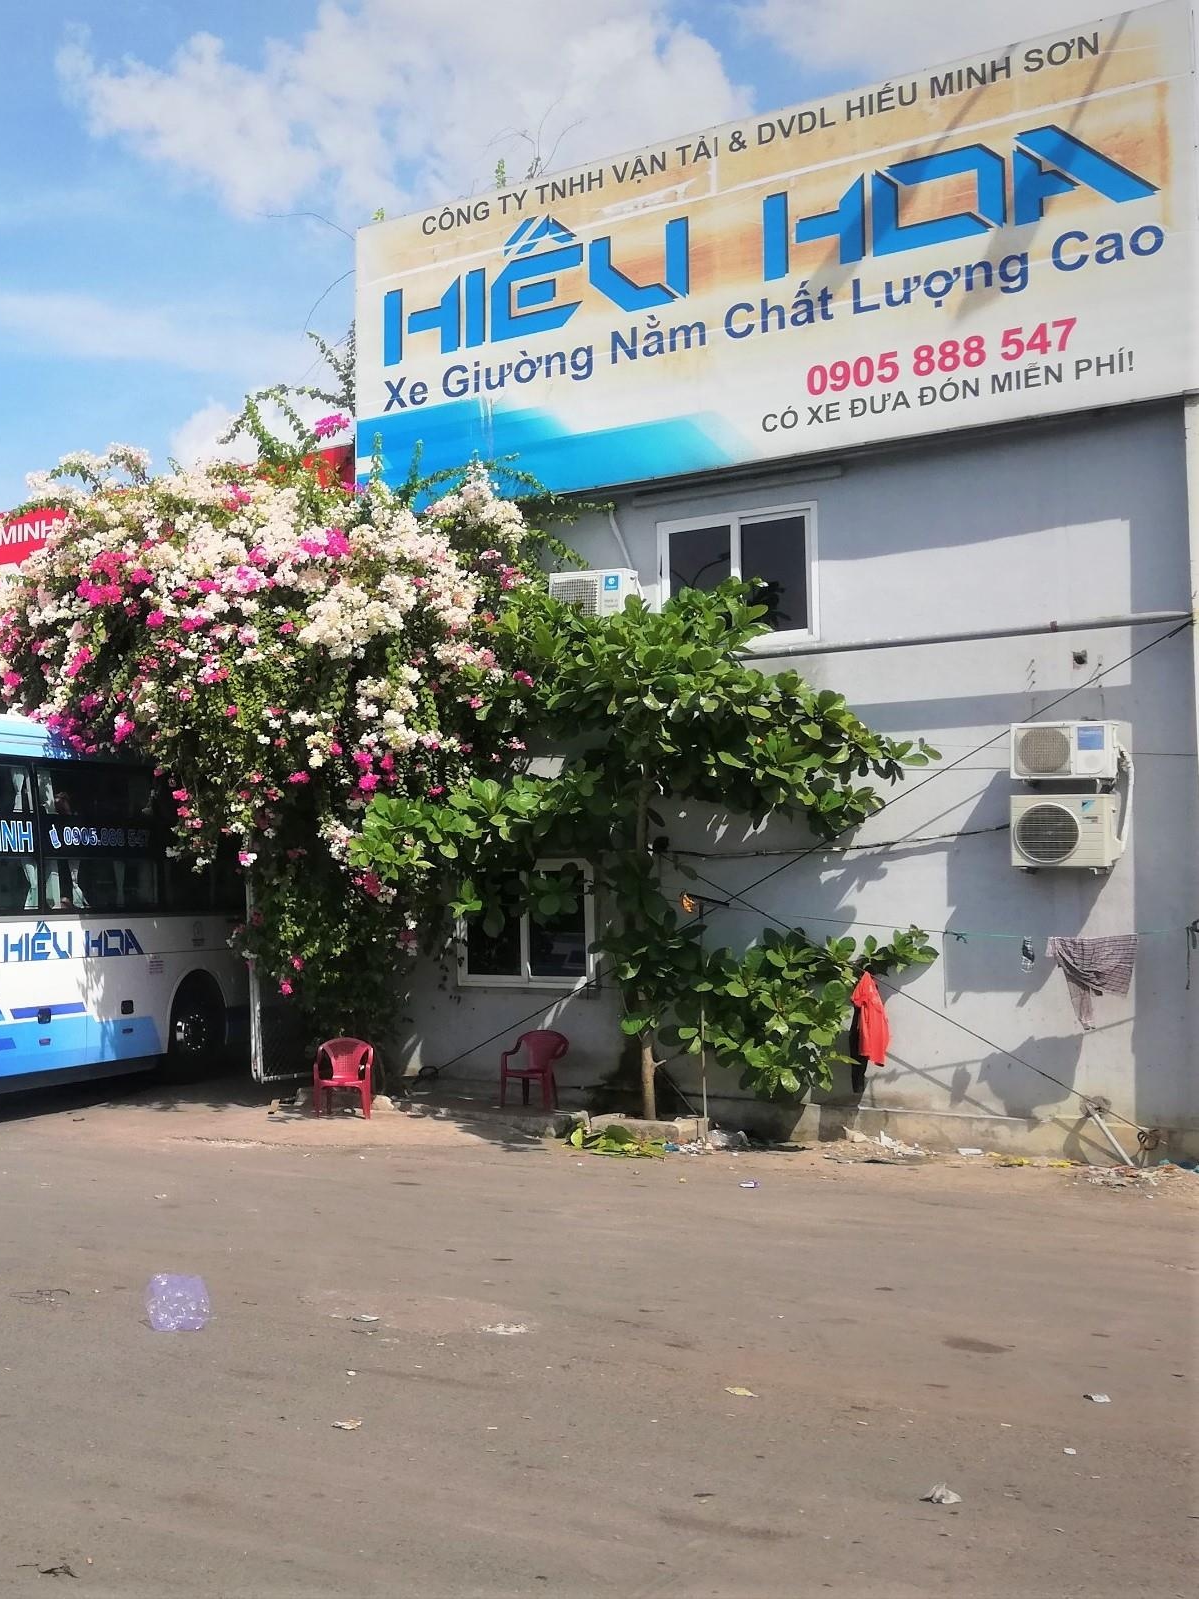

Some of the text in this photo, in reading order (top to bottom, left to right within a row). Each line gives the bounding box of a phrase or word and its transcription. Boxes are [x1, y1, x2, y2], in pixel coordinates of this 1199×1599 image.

[422, 31, 1099, 236] CÔNG TY TNHH VẬN TẢI & DVDL HIẾU MINH SƠN
[383, 224, 1165, 413] Xe Giường Nằm Chất Lượng Cao
[806, 317, 1078, 396] 0905 888 547
[761, 347, 1135, 433] CÓ XE ĐƯA ĐÓN MIỄN PHÍ!
